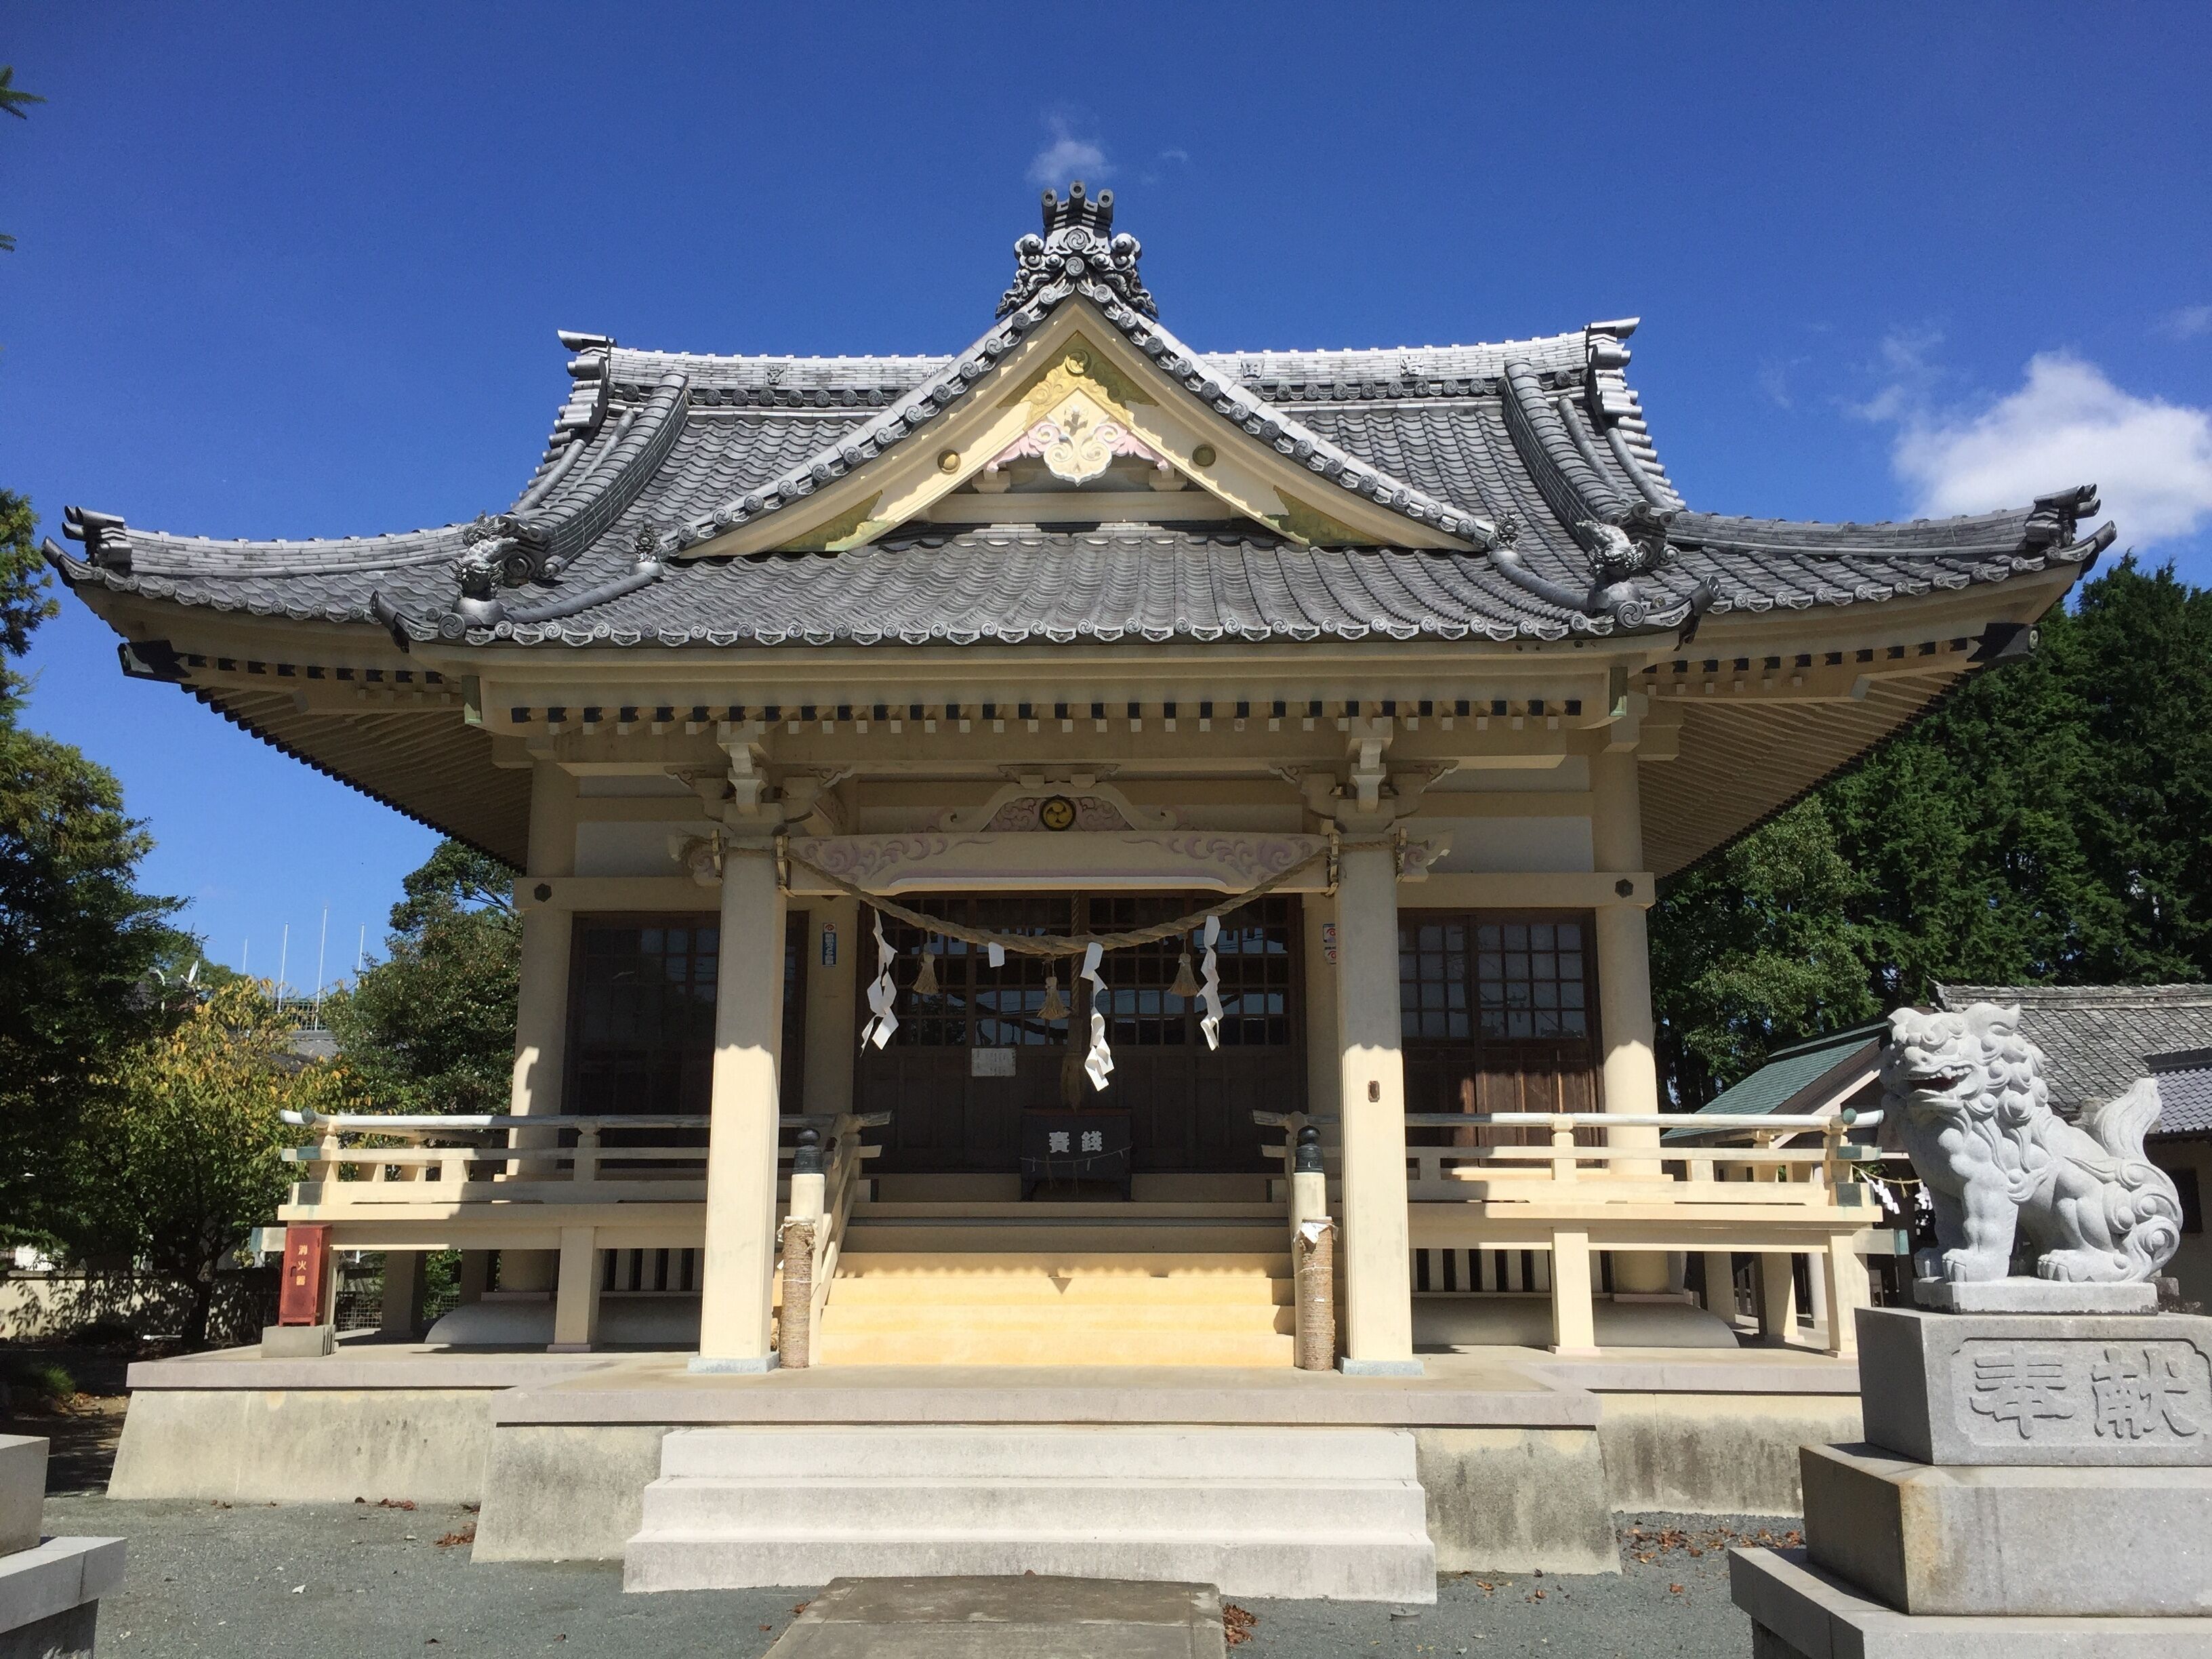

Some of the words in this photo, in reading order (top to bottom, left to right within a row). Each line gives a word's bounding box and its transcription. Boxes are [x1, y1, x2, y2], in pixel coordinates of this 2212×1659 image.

[296, 1244, 308, 1286] 消火器
[1969, 1348, 2198, 1439] 奉献
